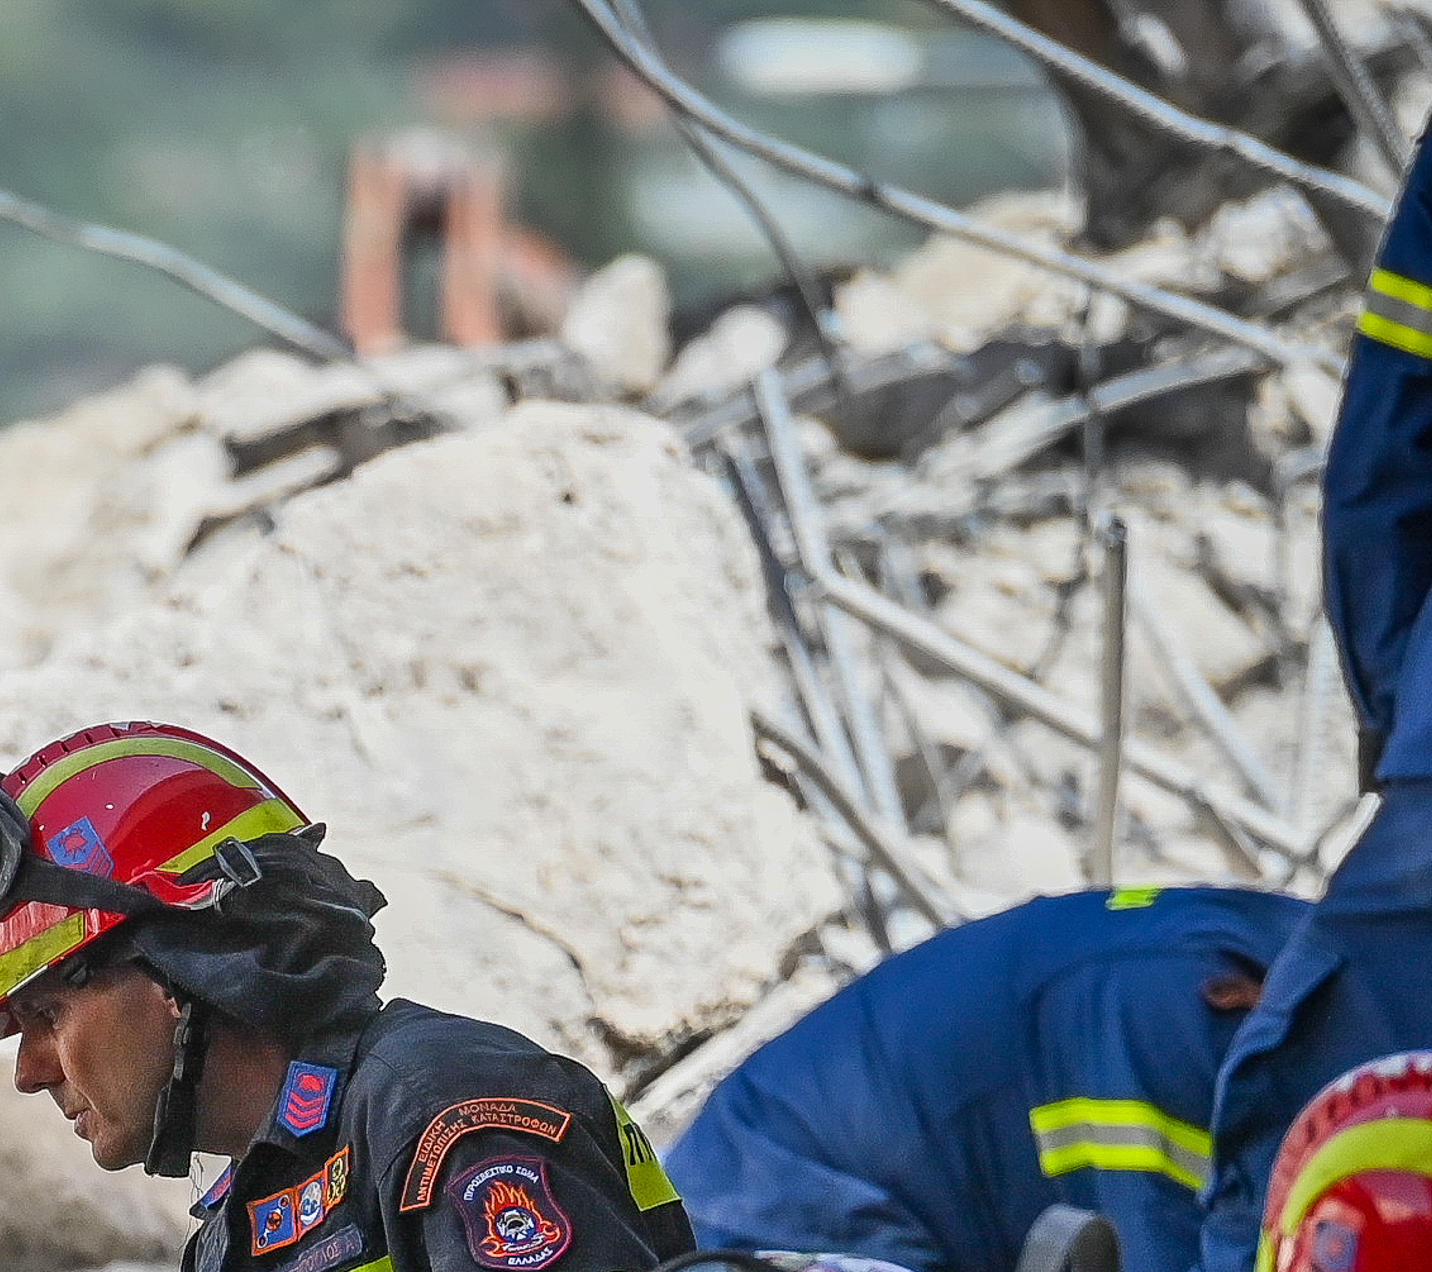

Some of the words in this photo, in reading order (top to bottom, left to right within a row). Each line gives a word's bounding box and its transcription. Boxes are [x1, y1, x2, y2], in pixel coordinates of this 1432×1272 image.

[418, 1120, 446, 1163] ΕΙΔΙΚΗ
[459, 1103, 516, 1116] ΜΟΝΑΔΑ
[472, 1113, 557, 1135] ΚΑΤΑΣΤΡΟΦΩΝ
